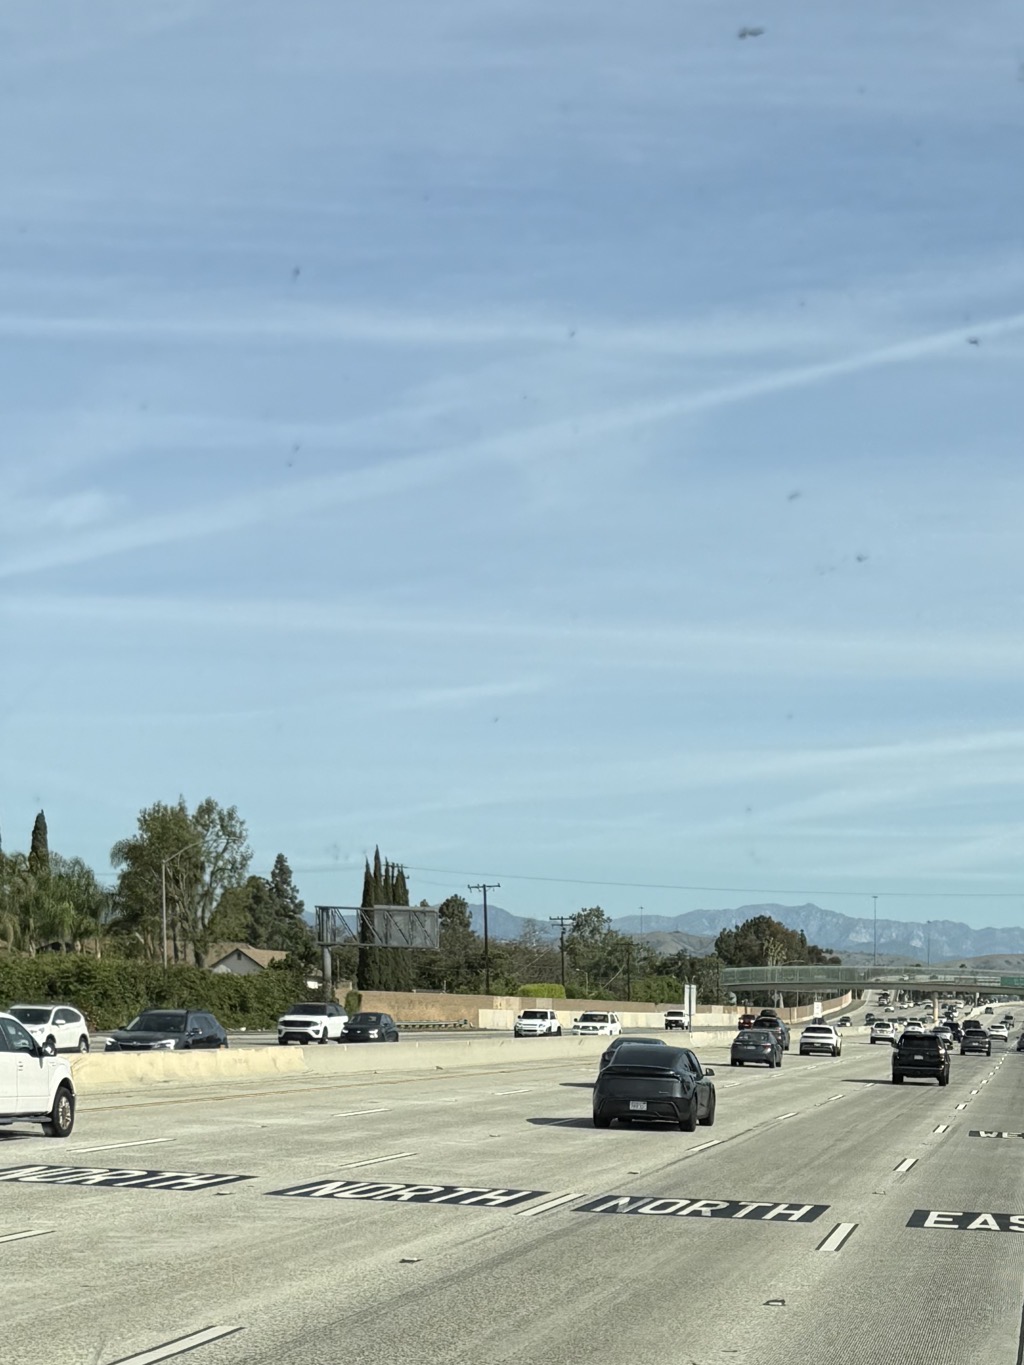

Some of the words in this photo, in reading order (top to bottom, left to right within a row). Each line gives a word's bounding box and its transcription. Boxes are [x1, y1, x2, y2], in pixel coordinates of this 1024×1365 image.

[0, 1165, 240, 1190] NORTH
[283, 1181, 533, 1206] NORTH
[590, 1196, 815, 1221] NORTH
